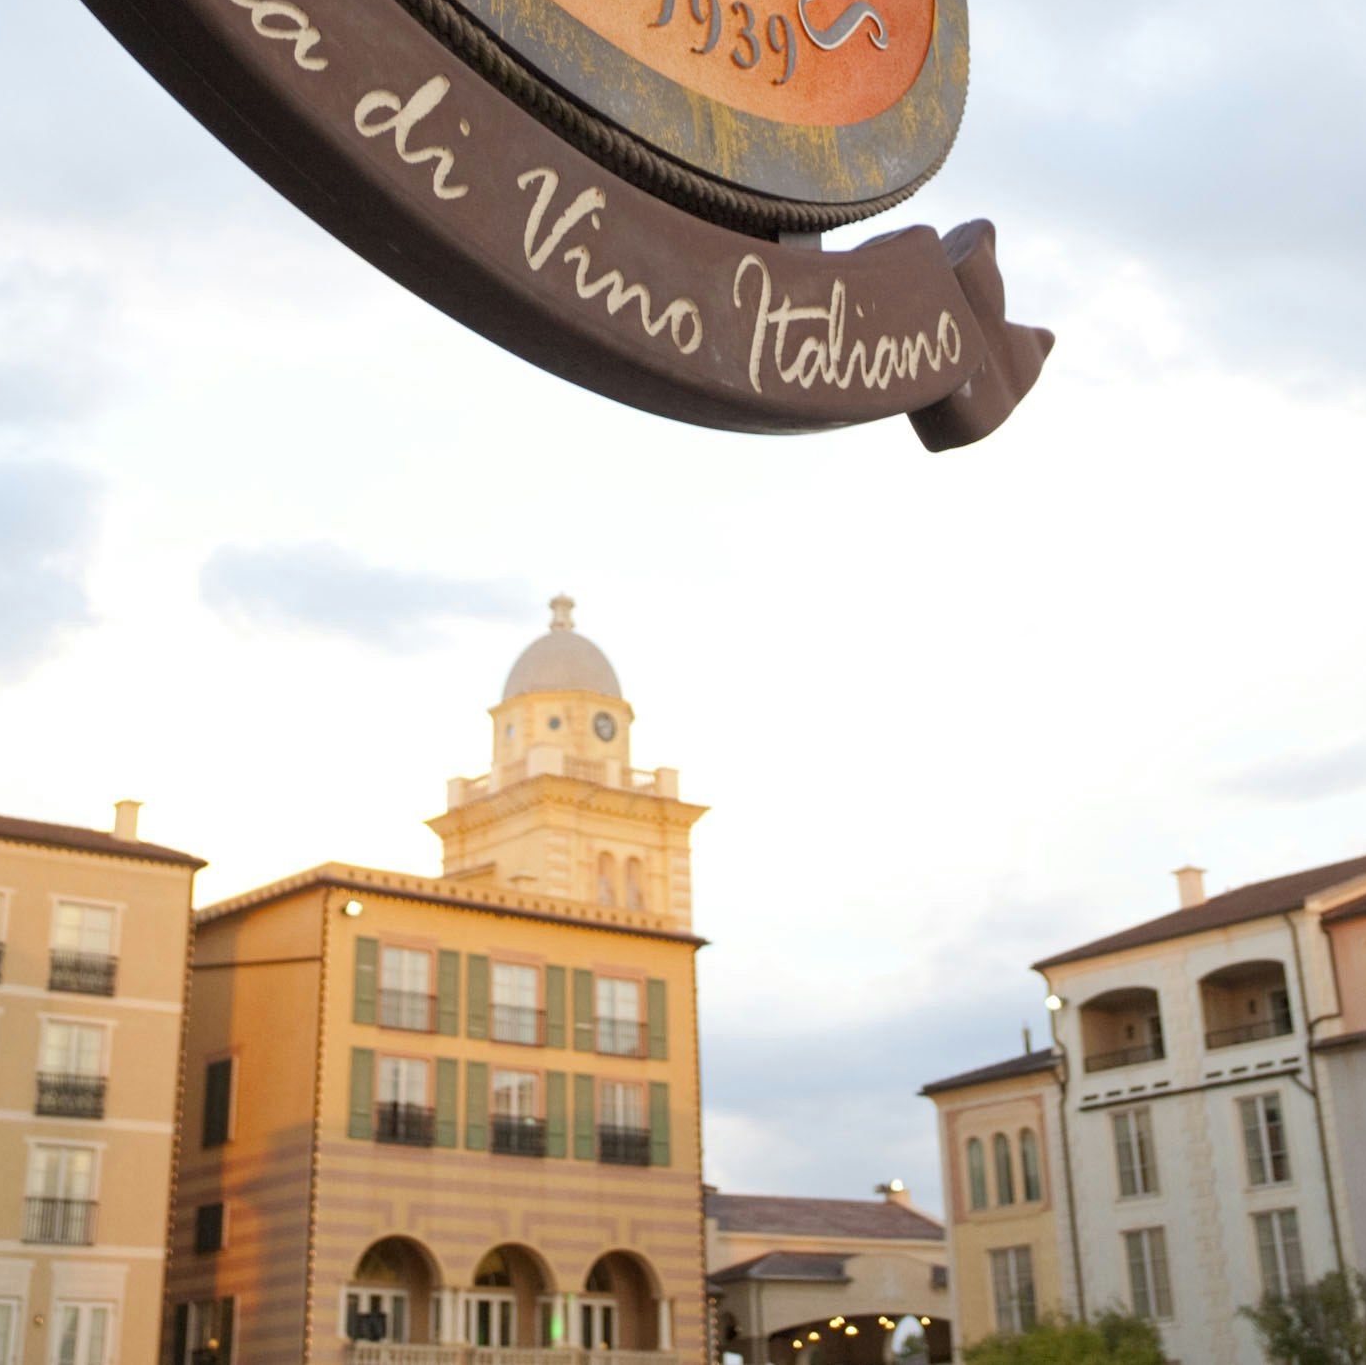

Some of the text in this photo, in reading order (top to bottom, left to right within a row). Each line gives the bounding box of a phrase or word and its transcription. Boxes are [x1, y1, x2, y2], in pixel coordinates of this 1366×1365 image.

[353, 72, 468, 200] di
[517, 166, 703, 355] Vino
[732, 253, 961, 393] Italiano
